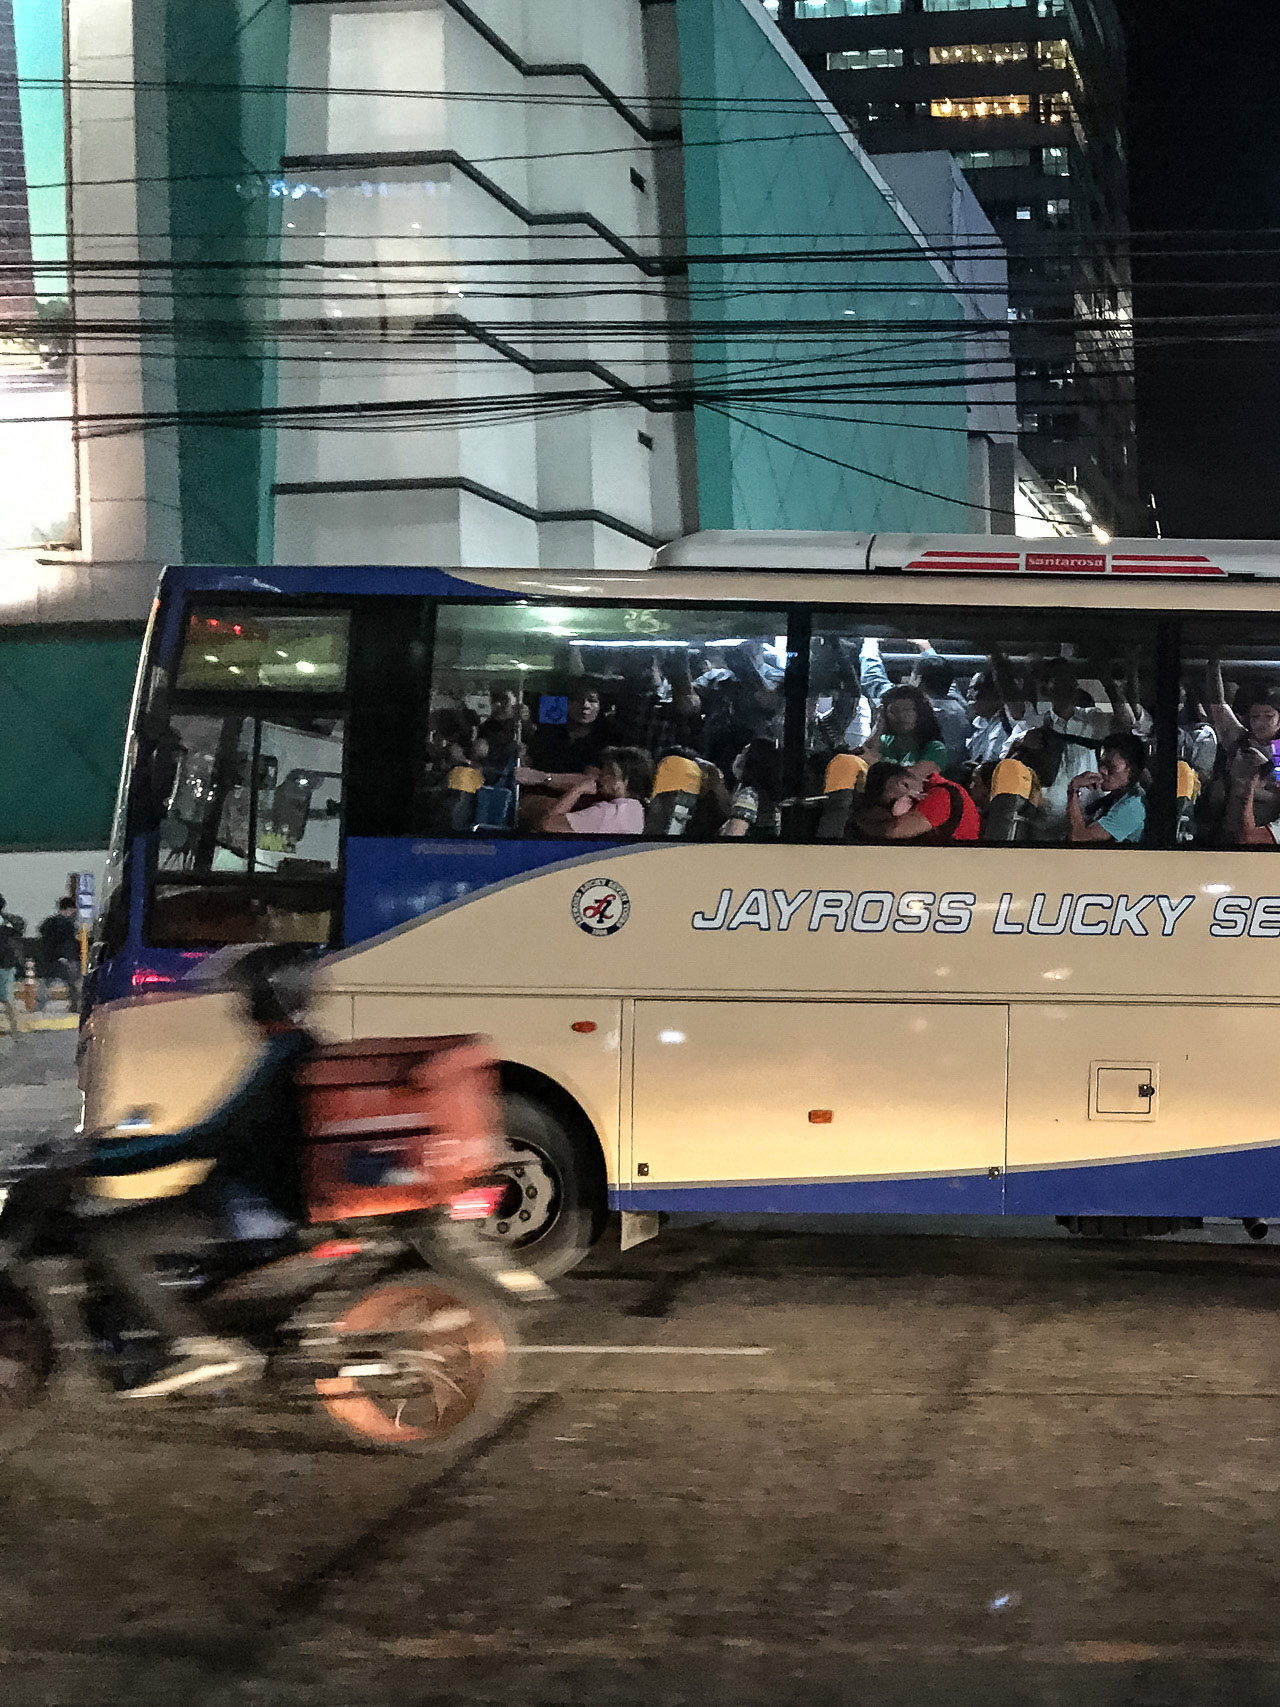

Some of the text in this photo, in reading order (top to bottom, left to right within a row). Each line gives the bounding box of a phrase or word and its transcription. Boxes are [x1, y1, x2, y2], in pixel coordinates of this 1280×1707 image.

[1028, 558, 1104, 567] santarosa
[692, 888, 976, 934] JAYROSS
[993, 892, 1196, 937] LUCKY
